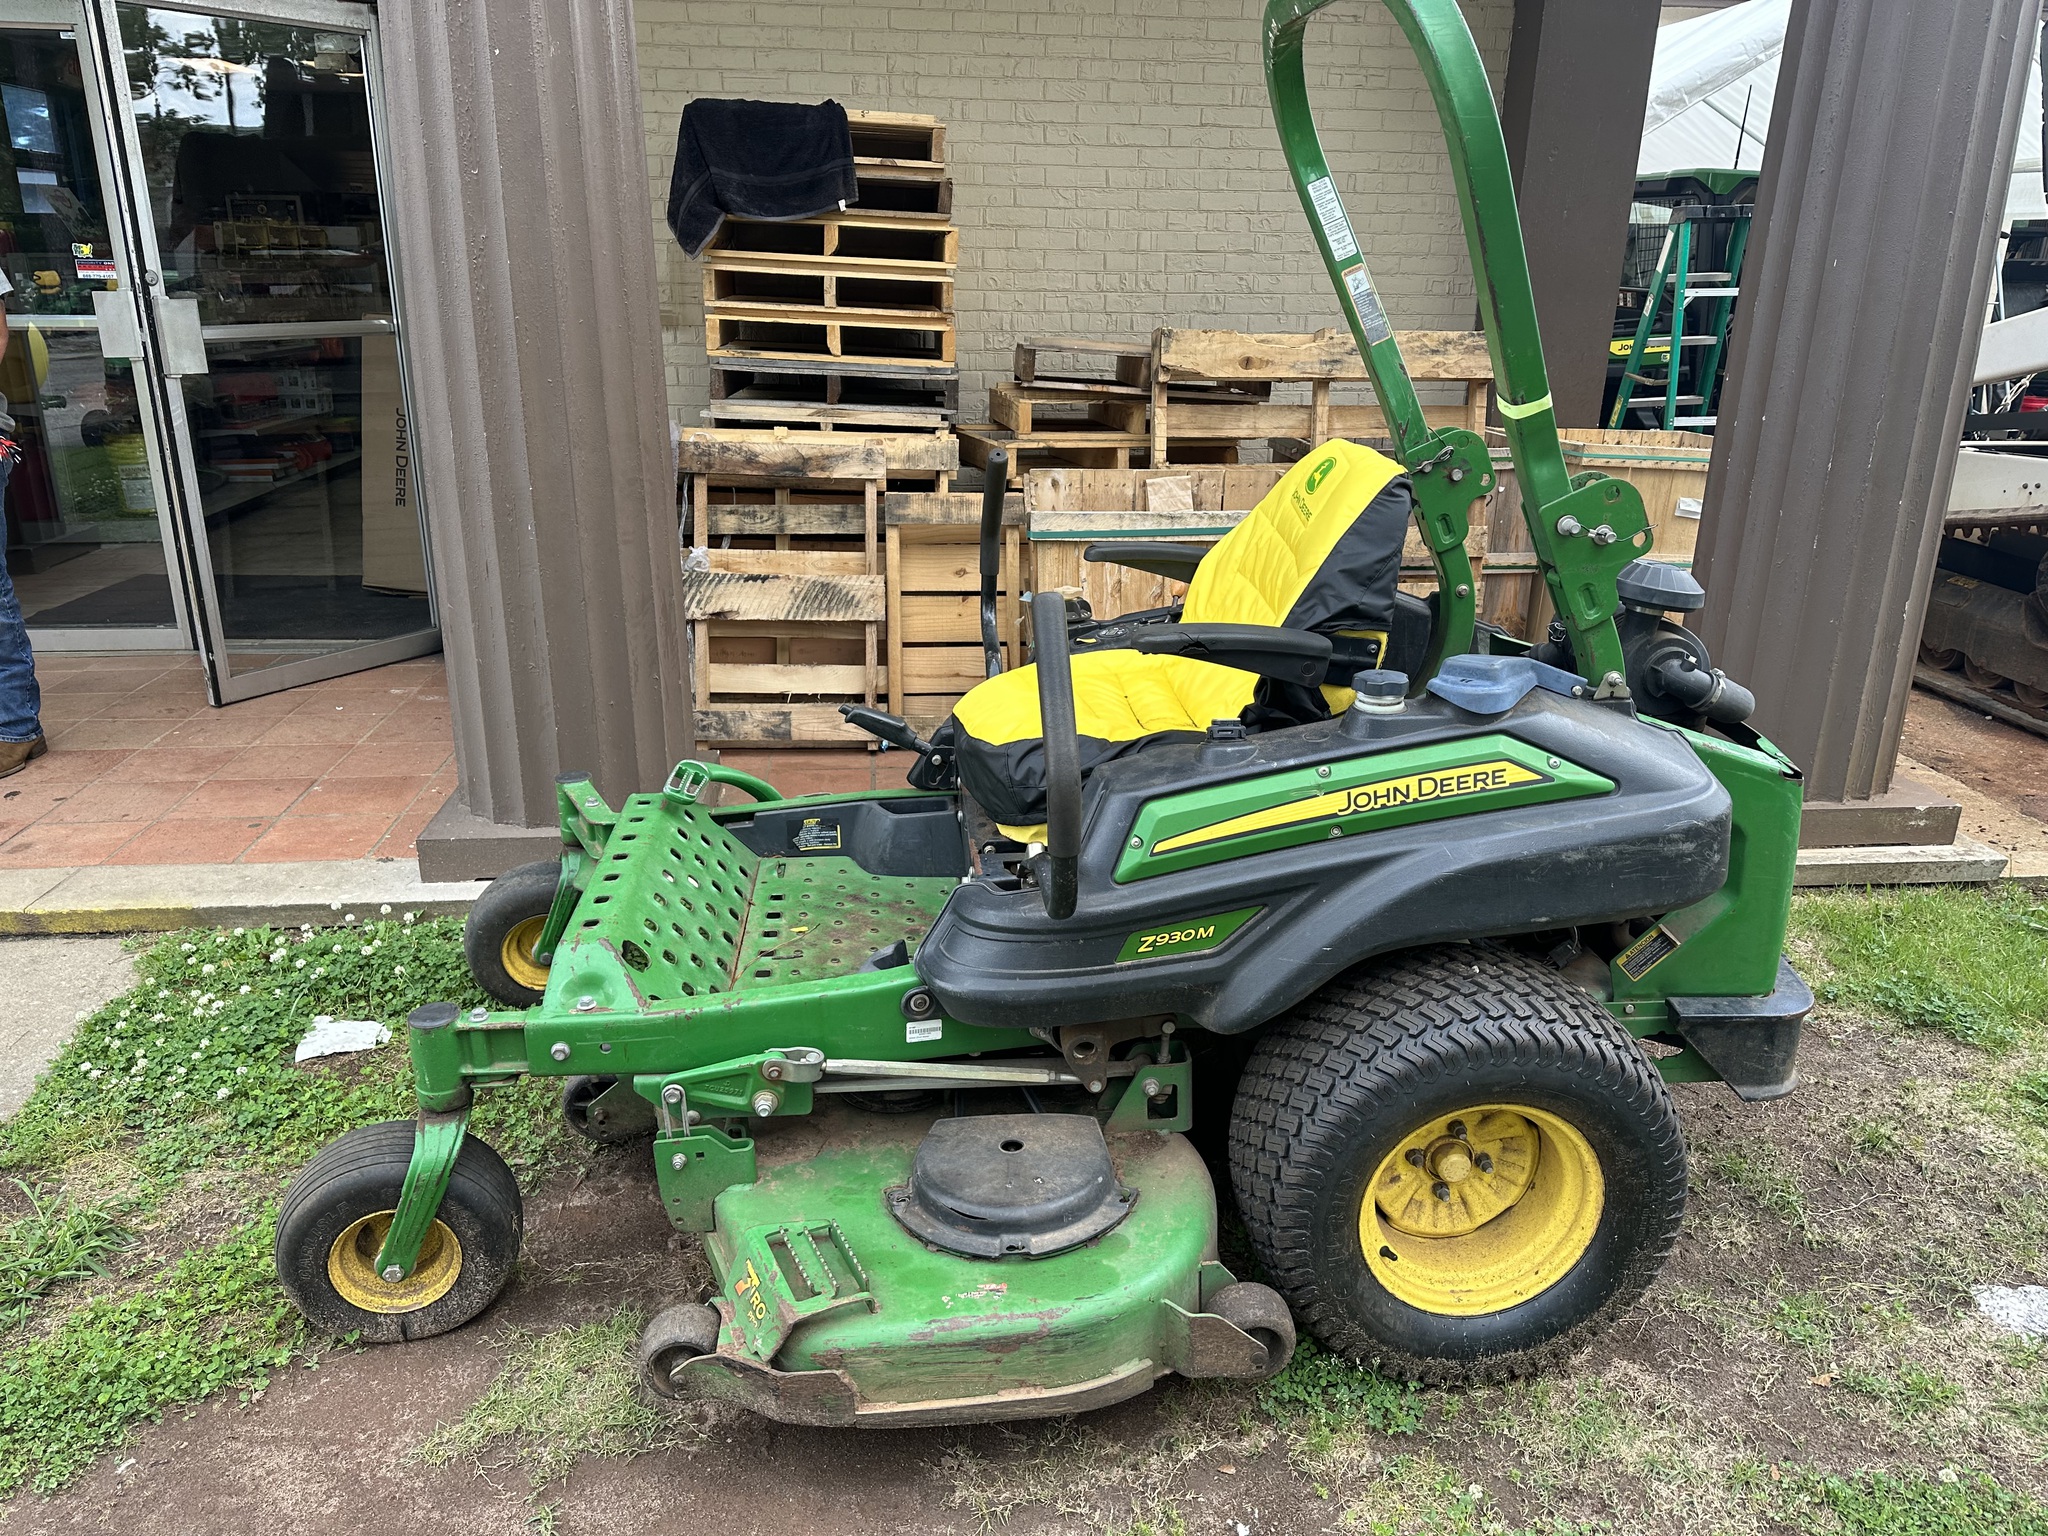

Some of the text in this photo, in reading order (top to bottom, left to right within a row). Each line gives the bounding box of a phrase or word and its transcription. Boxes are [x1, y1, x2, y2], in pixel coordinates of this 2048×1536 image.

[395, 407, 409, 507] JOHN DEERE
[1337, 768, 1507, 814] JOHN DEERE
[1136, 925, 1215, 953] Z930M
